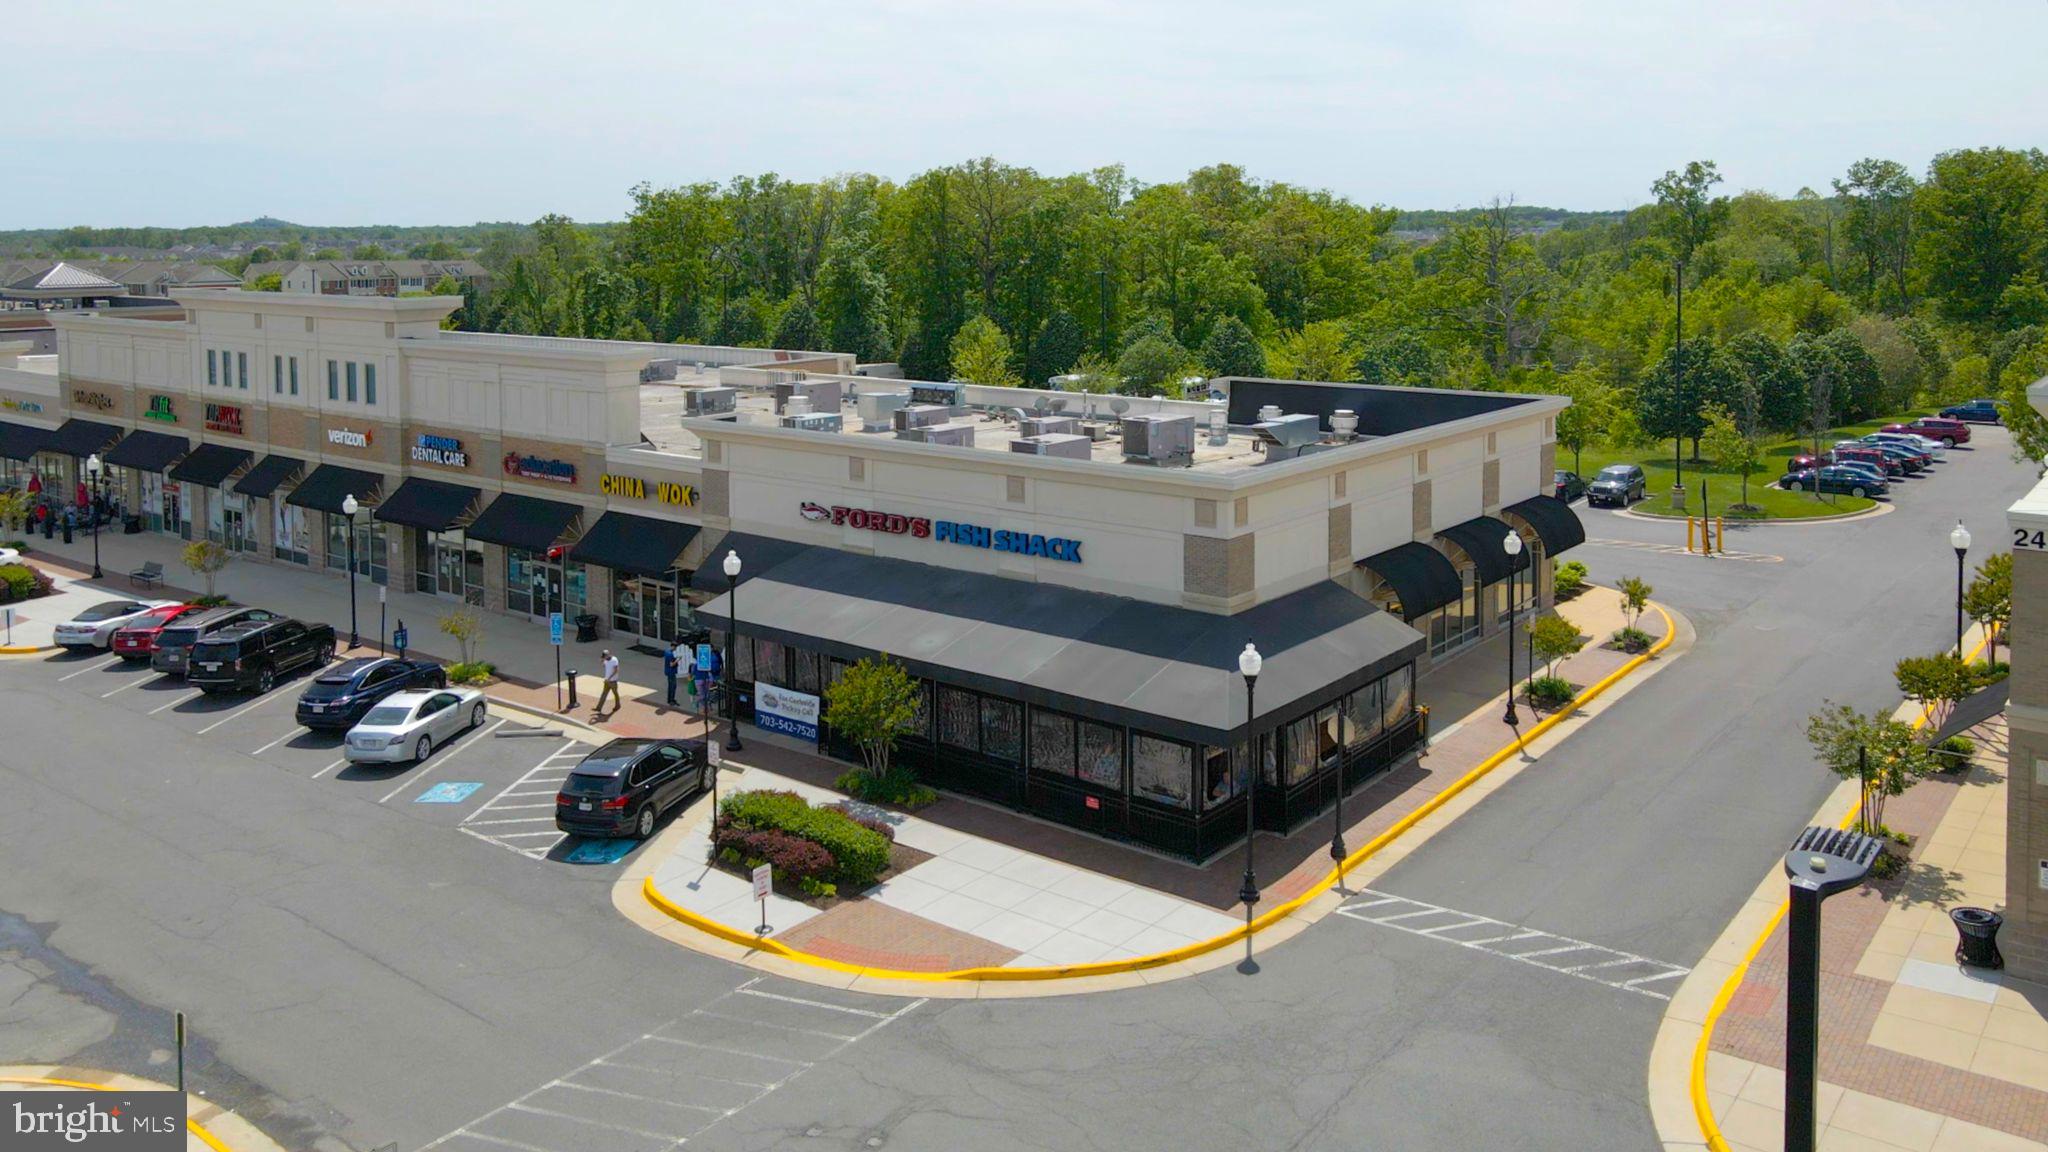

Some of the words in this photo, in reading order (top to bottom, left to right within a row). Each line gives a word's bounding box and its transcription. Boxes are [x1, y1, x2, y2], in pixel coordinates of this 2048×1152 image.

[328, 428, 367, 447] verizon
[425, 435, 459, 451] PENDER
[411, 446, 443, 464] DENTAL
[443, 450, 466, 467] CARE
[601, 475, 646, 499] CHINA
[653, 482, 693, 507] WOK
[831, 506, 931, 538] FORD'S
[935, 521, 991, 549] FISH
[993, 530, 1082, 563] SHACK
[2014, 529, 2047, 549] 24
[760, 714, 817, 738] 703-542-7520
